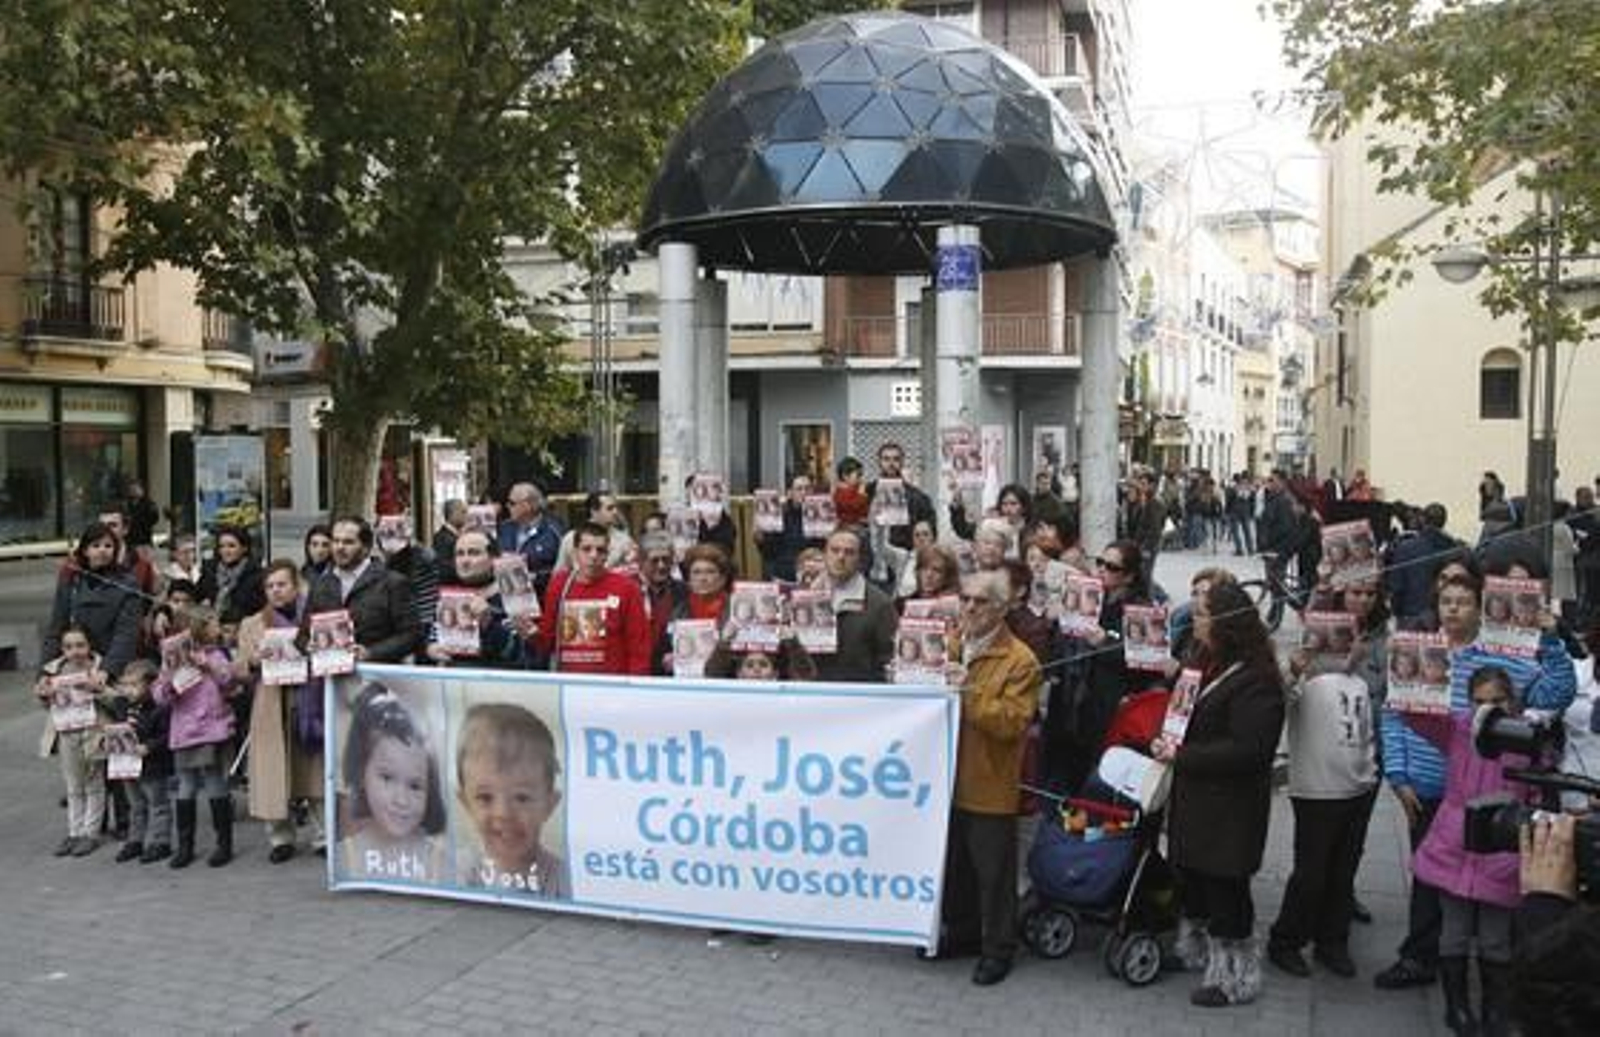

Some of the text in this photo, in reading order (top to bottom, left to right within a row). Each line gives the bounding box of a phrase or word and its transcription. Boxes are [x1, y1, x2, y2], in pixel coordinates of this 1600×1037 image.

[583, 727, 931, 807] Ruth, José,
[637, 797, 869, 858] Córdoba
[365, 850, 425, 878] Ruth
[481, 860, 541, 891] José
[583, 849, 935, 902] está con vosotros
